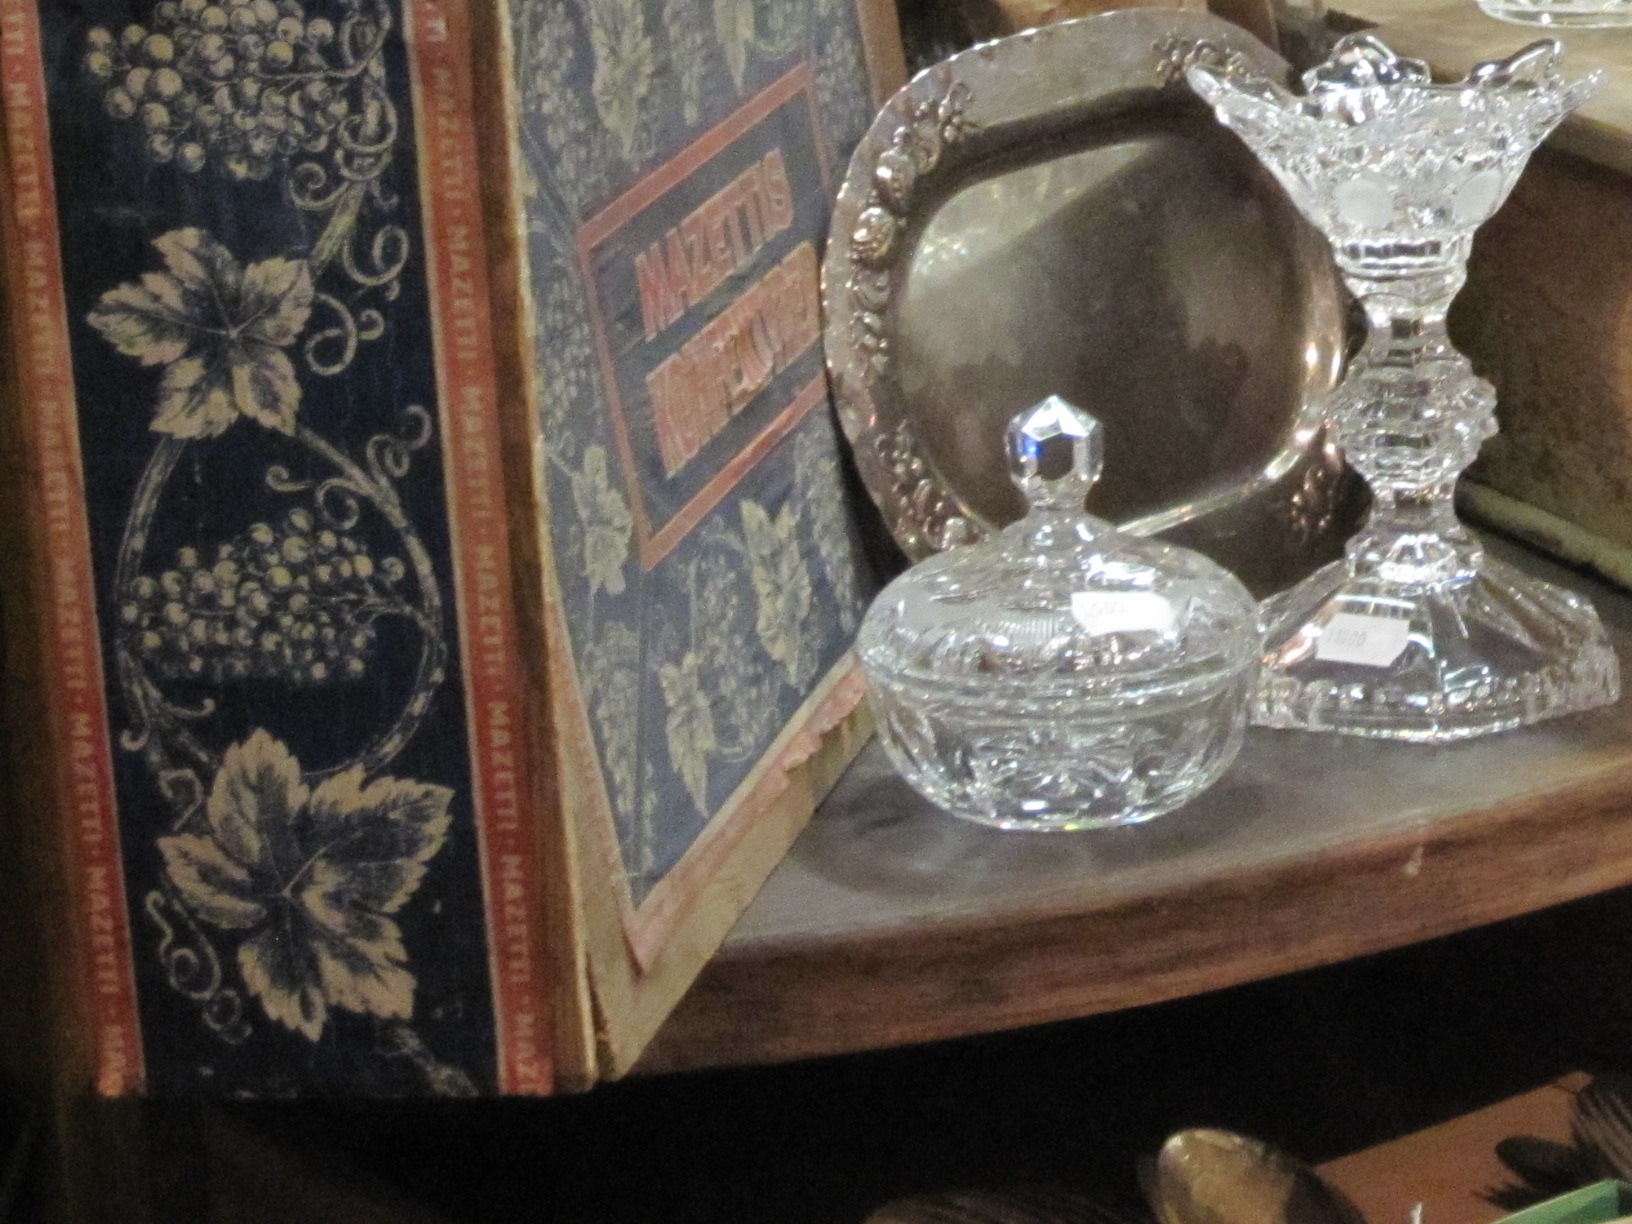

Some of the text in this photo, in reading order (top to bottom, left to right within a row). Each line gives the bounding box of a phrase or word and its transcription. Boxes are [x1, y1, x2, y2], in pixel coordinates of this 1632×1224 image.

[448, 226, 477, 360] MAZETTI
[460, 386, 491, 519] MAZETTI
[475, 544, 505, 676] MAZETTI
[68, 712, 103, 842] MAZETTI
[486, 700, 519, 830] MAZETTI
[83, 864, 119, 994] MAZETTI
[498, 854, 531, 982] MAZETTI
